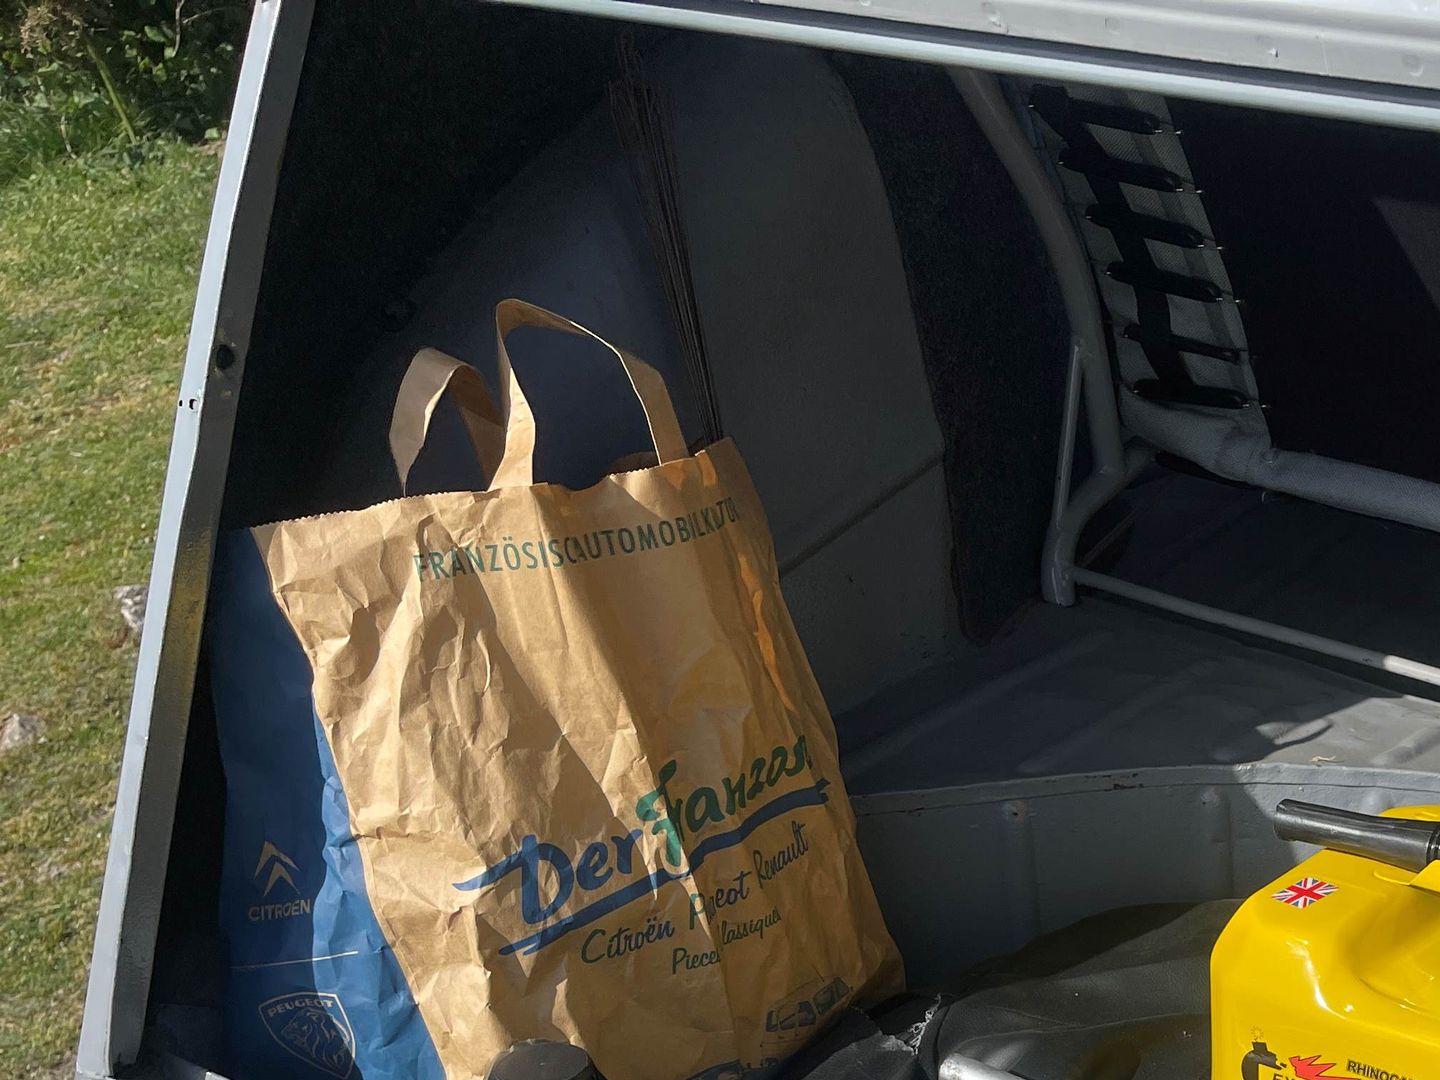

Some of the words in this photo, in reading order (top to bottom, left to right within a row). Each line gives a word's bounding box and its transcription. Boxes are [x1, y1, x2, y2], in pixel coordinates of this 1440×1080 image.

[413, 536, 577, 583] FRANZÖSISC
[249, 898, 311, 922] CITROËN
[452, 829, 644, 925] Der
[580, 914, 676, 964] Citroën
[753, 820, 809, 889] Renault
